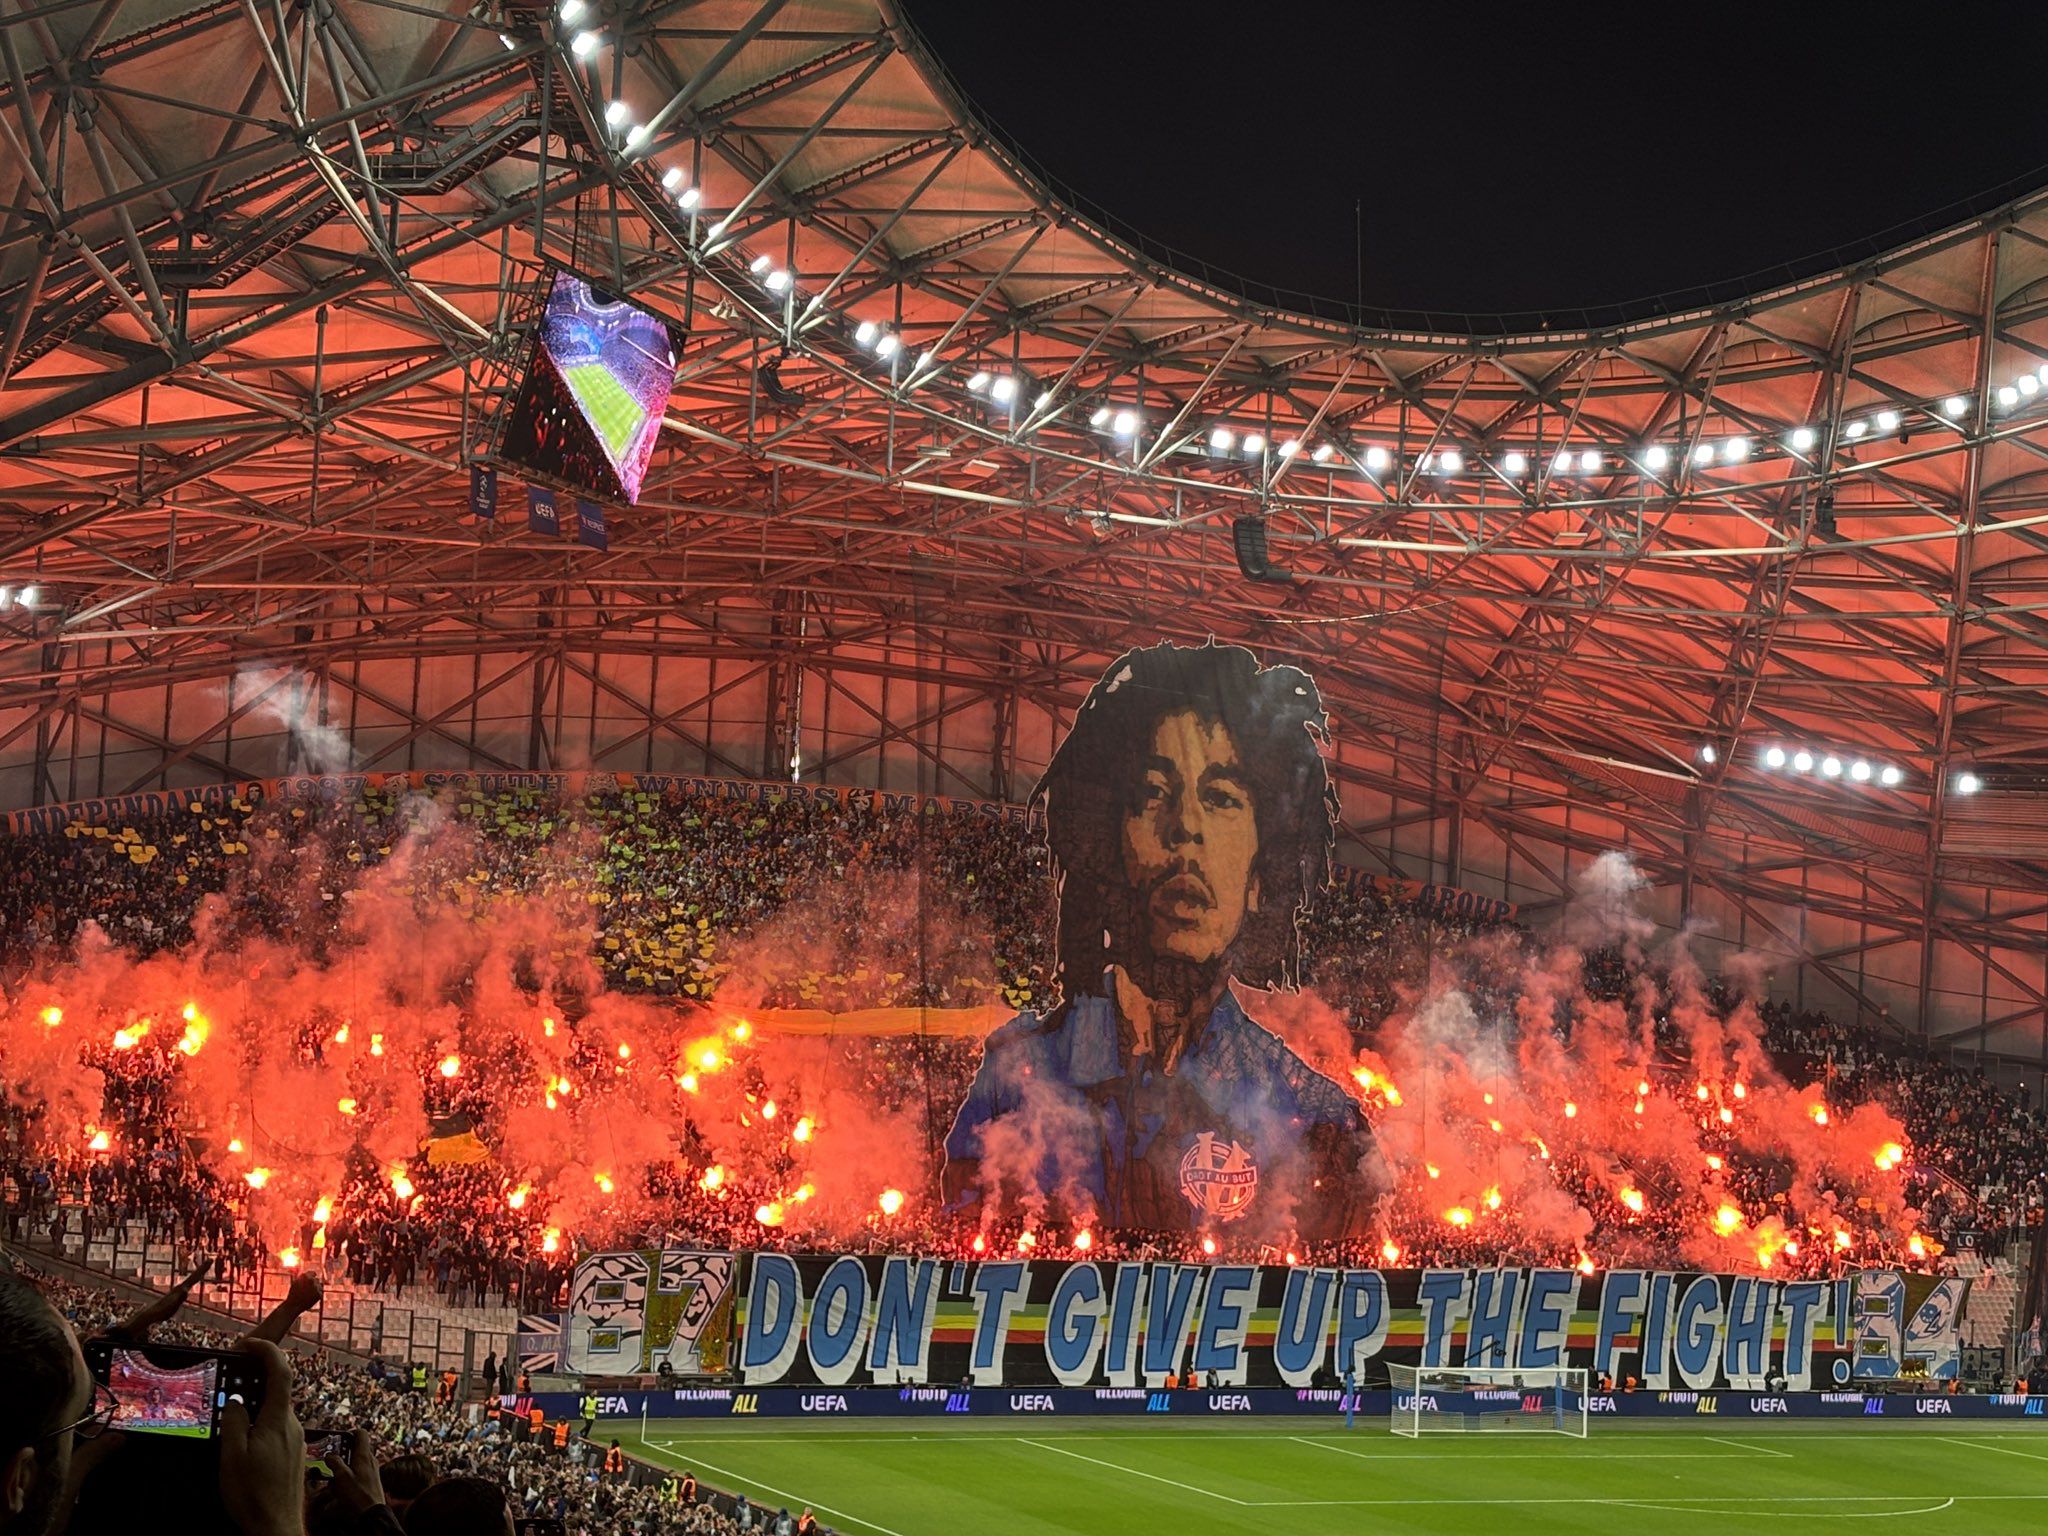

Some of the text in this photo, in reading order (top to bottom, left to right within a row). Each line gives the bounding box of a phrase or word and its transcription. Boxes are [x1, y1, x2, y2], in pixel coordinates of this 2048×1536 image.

[276, 776, 369, 800] 1987
[632, 774, 840, 804] WINNERS
[880, 793, 1048, 831] MARSEI
[1418, 884, 1511, 920] GROUP
[1215, 1174, 1229, 1184] AU
[1232, 1173, 1252, 1184] BUT
[564, 1251, 735, 1375] 87
[744, 1252, 1854, 1391] DON'T GIVE UP THE FIGHT!
[732, 1394, 759, 1414] ALL
[801, 1394, 848, 1411] UEFA
[945, 1393, 970, 1412] ALL
[1010, 1394, 1055, 1411] UEFA
[1146, 1394, 1171, 1412] ALL
[1209, 1394, 1252, 1411] UEFA
[1338, 1394, 1362, 1412] AL
[1521, 1394, 1543, 1413] ALL
[1577, 1397, 1617, 1412] UEFA
[1695, 1396, 1718, 1414] ALL
[1750, 1397, 1788, 1413] UEFA
[1863, 1397, 1884, 1414] ALL
[1916, 1398, 1952, 1413] UEFA
[2024, 1398, 2044, 1414] ALL
